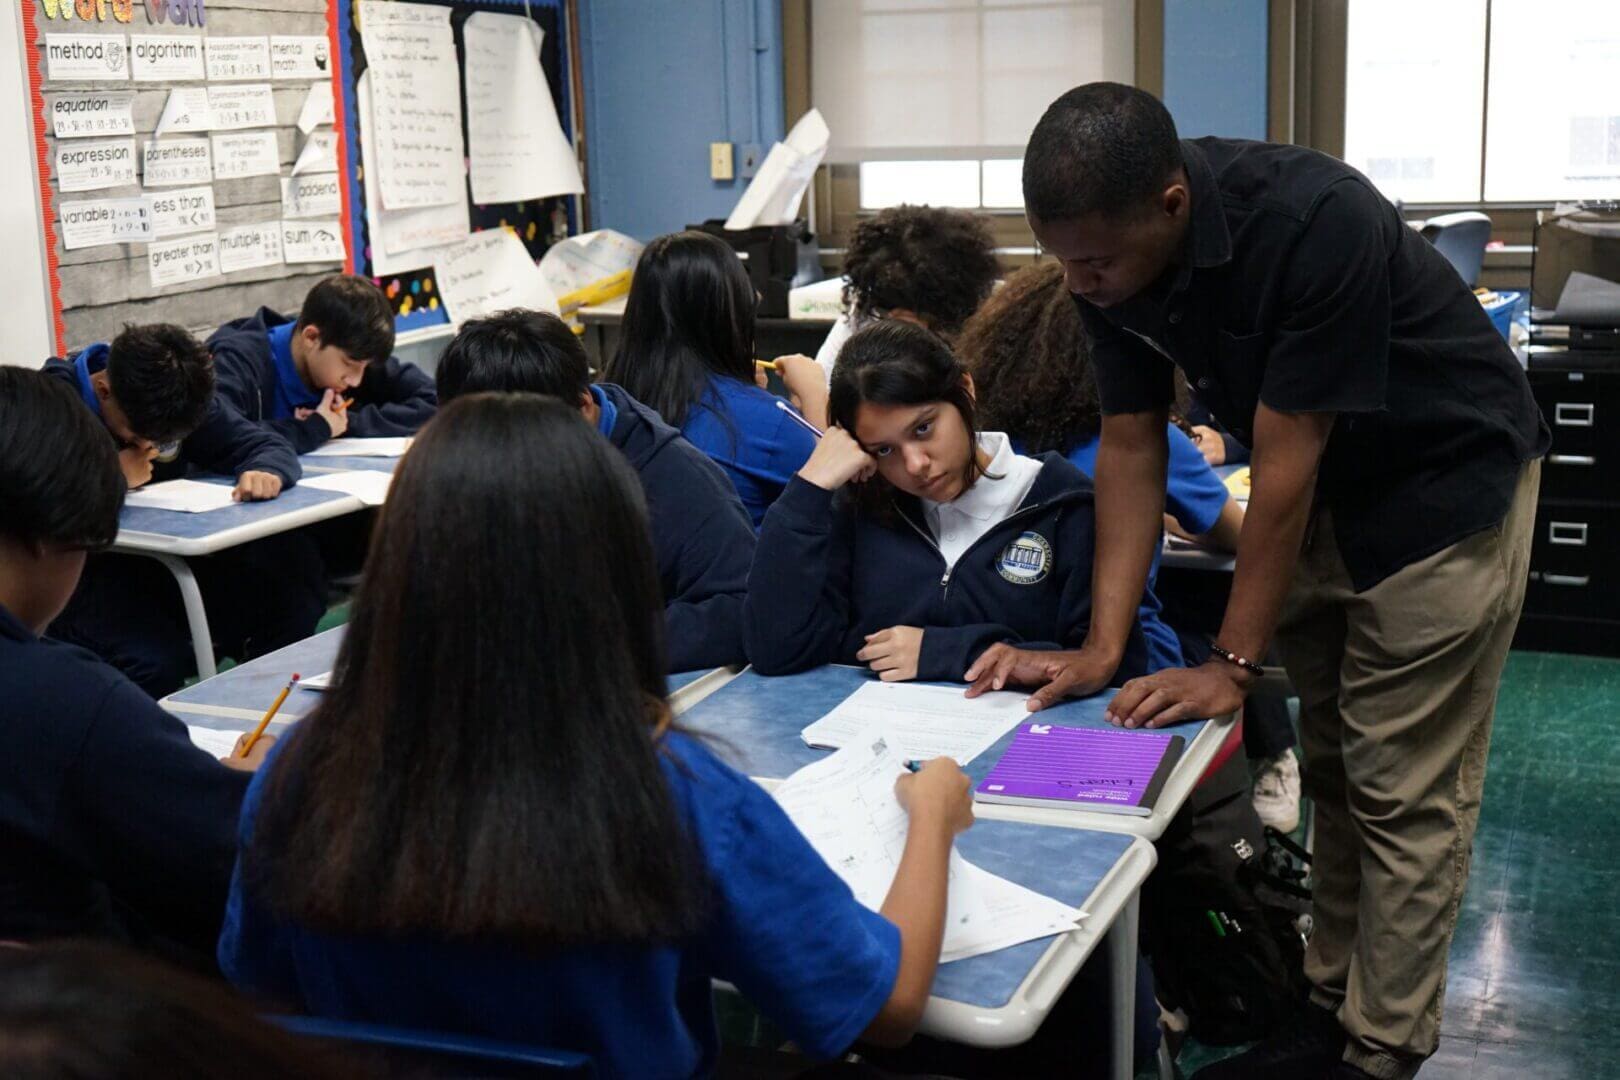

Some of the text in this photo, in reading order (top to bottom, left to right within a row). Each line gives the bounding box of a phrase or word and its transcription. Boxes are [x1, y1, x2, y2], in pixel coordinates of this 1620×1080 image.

[50, 42, 103, 59] method
[136, 40, 196, 63] algorithm
[273, 59, 297, 71] math
[55, 98, 109, 115] equation
[61, 146, 129, 166] expression
[146, 145, 207, 162] parentheses
[299, 183, 338, 198] addend
[153, 194, 207, 213] ess than
[63, 206, 109, 224] variable
[220, 231, 261, 250] multiple
[285, 230, 311, 244] sum
[152, 246, 190, 267] greater
[192, 241, 215, 256] than
